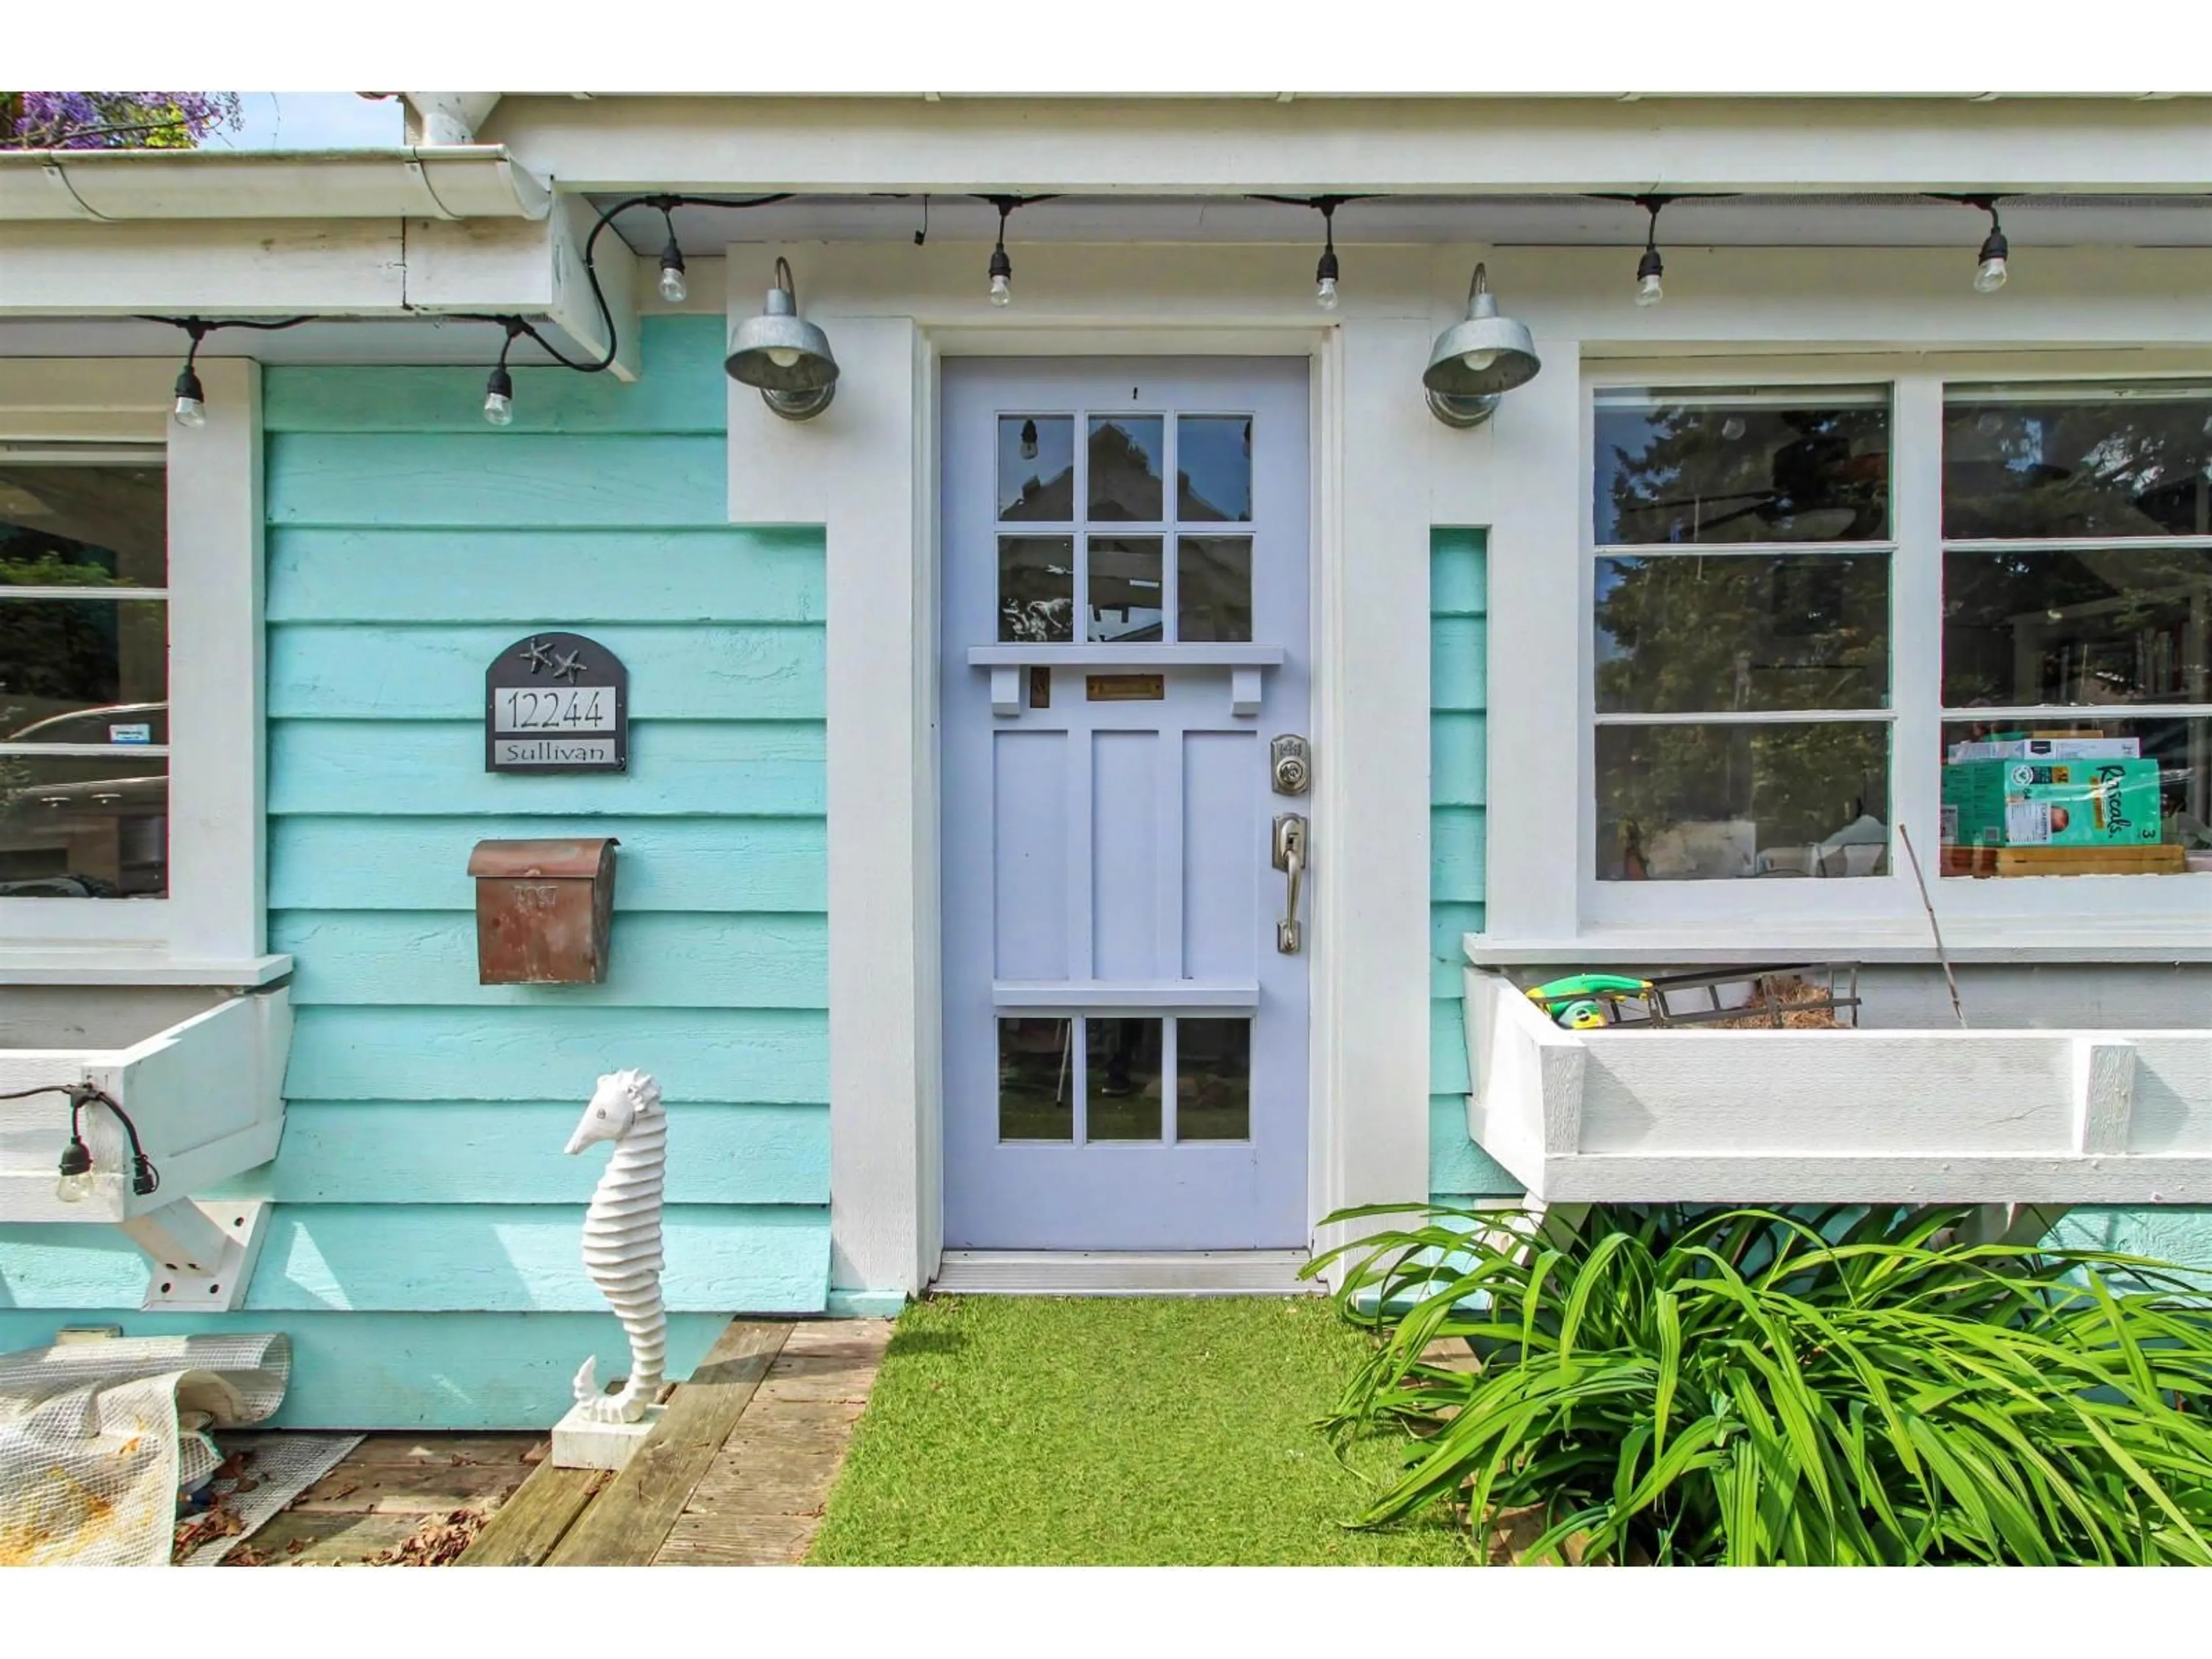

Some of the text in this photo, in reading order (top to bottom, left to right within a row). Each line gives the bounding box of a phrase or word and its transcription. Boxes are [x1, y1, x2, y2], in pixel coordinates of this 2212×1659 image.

[508, 691, 603, 728] 12244
[507, 742, 604, 762] Sullivan
[2142, 829, 2156, 839] 3
